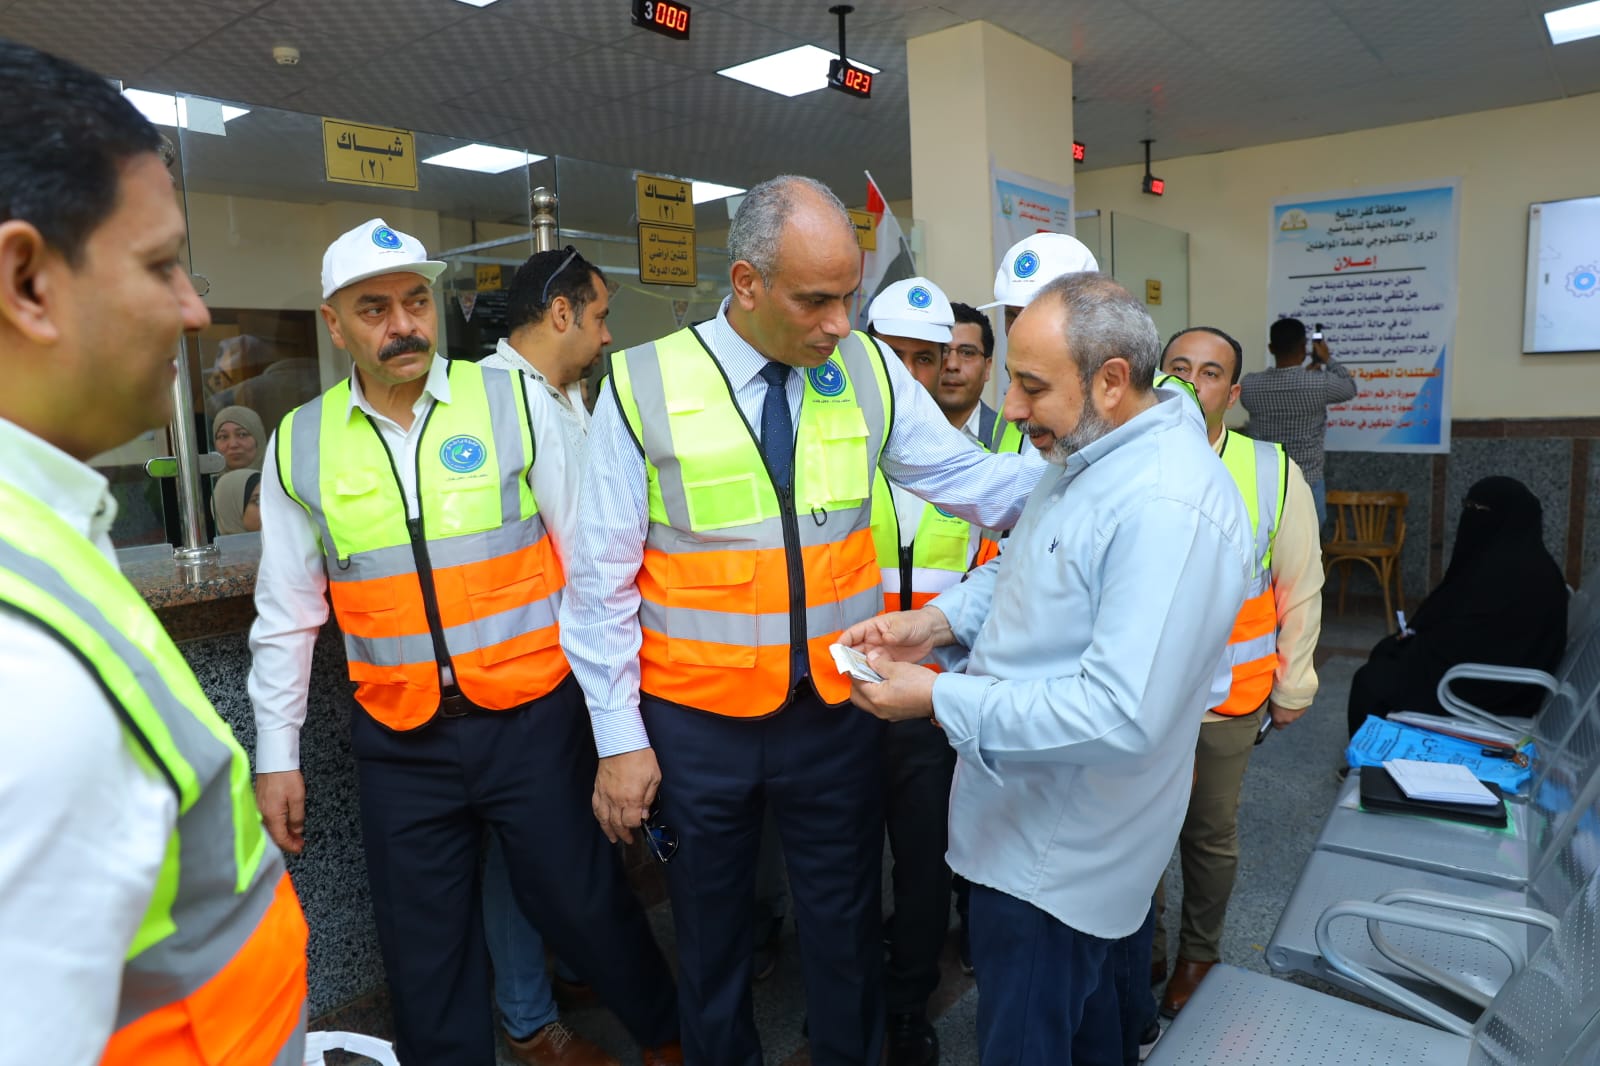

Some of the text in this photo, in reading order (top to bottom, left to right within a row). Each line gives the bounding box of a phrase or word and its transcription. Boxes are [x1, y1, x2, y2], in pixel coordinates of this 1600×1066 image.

[644, 1, 688, 32] 3 000
[845, 69, 871, 93] 023
[336, 131, 403, 161] شباك
[644, 184, 686, 206] شباك
[1335, 205, 1407, 222] محافظة كفر الشيخ
[1333, 255, 1378, 271] إعلان
